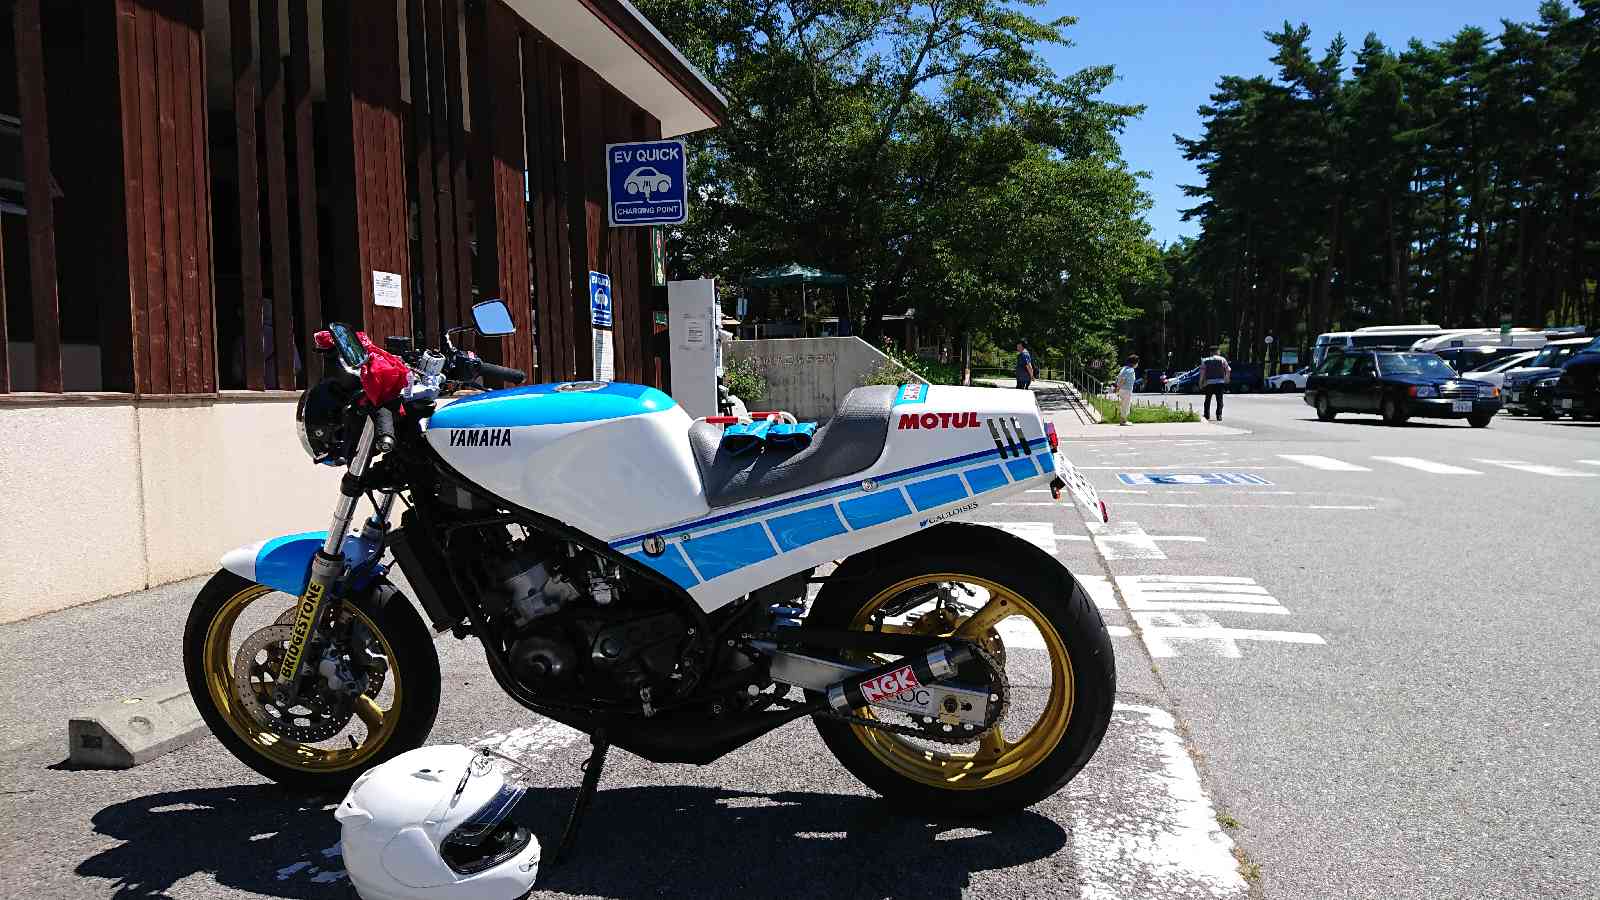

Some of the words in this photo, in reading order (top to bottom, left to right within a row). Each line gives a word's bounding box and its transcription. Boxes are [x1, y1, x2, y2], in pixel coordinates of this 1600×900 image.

[615, 150, 632, 164] EV
[636, 148, 679, 162] QUICK
[617, 207, 655, 216] CHARGING
[656, 205, 679, 214] POINT
[898, 412, 981, 430] MOTUL
[450, 429, 512, 446] YAMAHA
[281, 582, 321, 678] BRIDGESTONE
[863, 668, 916, 701] NGK
